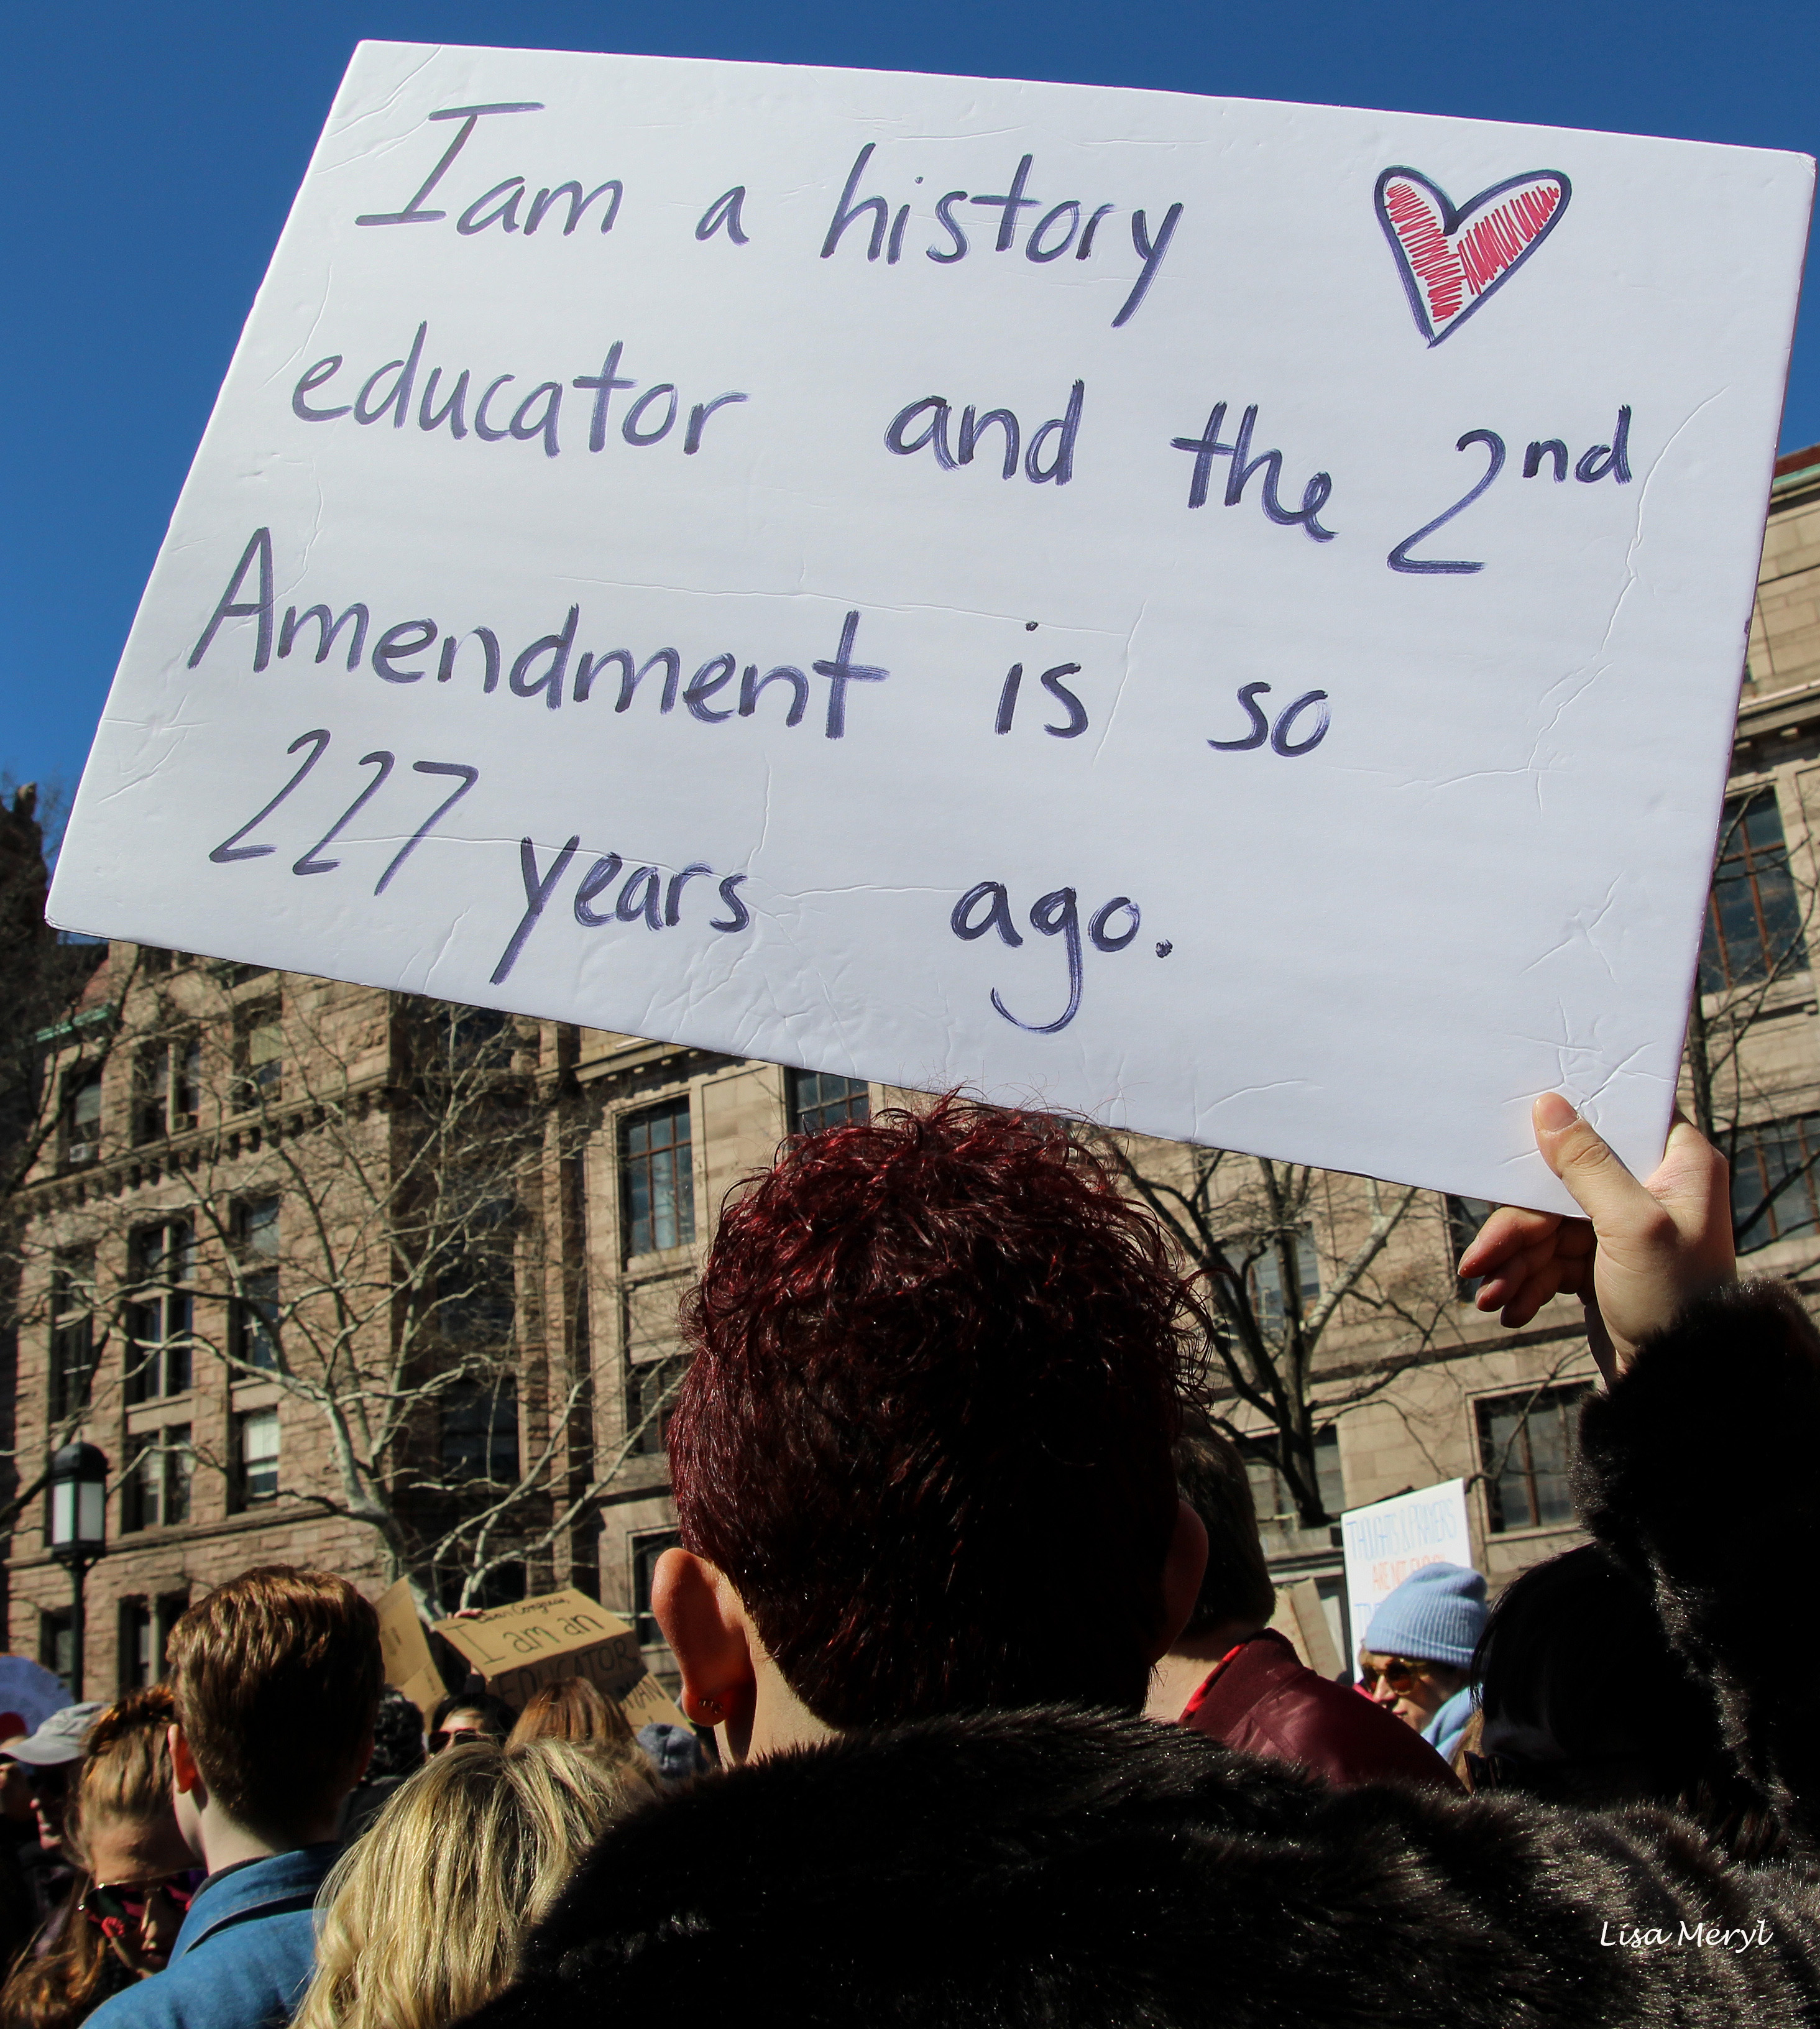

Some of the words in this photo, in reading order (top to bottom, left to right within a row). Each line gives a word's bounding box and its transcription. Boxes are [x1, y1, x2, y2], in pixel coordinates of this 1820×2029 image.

[695, 185, 749, 244] a
[820, 142, 1183, 328] history
[292, 321, 750, 456] educator
[883, 379, 1085, 486] and
[1170, 400, 1340, 544] the
[1386, 403, 1634, 574] 2nd
[187, 527, 890, 741] Amendment
[995, 620, 1090, 740] is
[1206, 681, 1331, 758] so
[208, 728, 480, 897] 227
[489, 834, 751, 987] years
[950, 880, 1174, 1036] ago.
[445, 1622, 505, 1666] I
[502, 1626, 561, 1654] am
[563, 1612, 605, 1637] an
